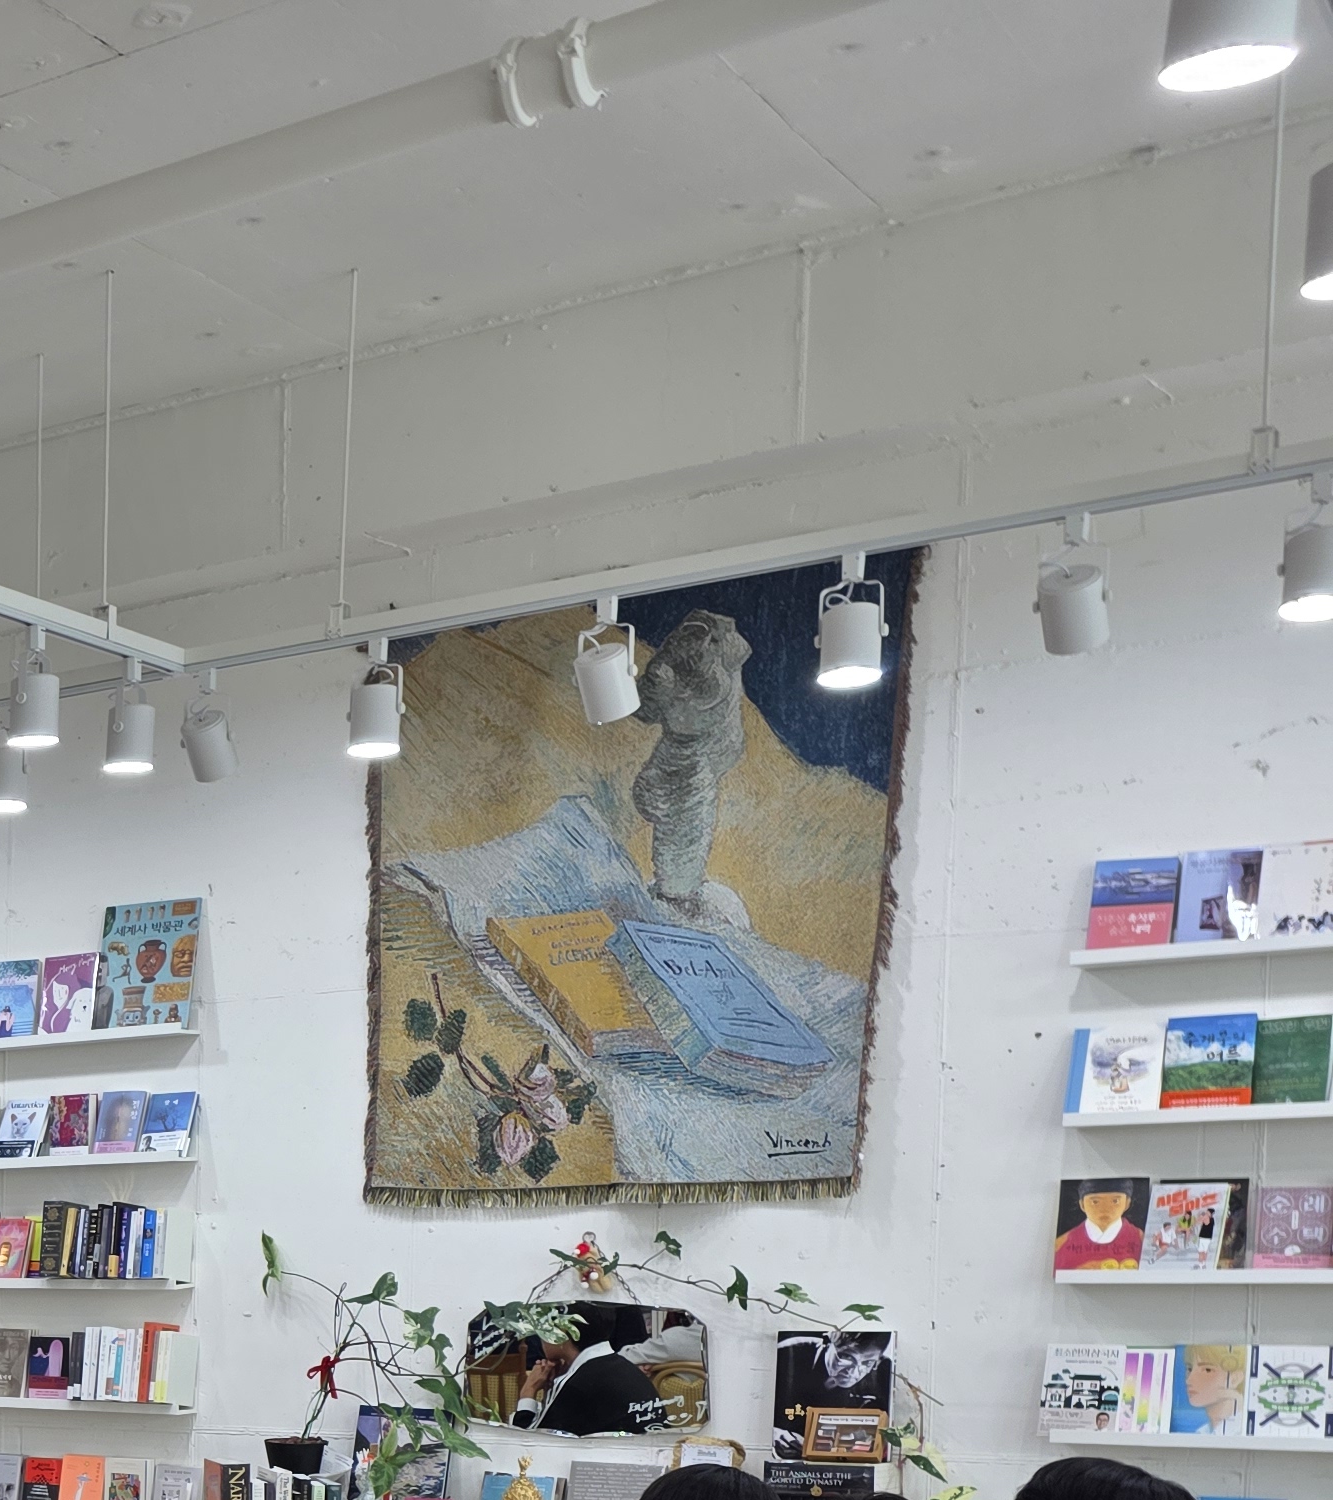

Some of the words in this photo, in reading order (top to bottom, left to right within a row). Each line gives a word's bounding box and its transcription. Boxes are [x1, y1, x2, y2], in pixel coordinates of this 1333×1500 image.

[114, 922, 147, 937] 세계사
[151, 919, 184, 934] 박물관
[788, 1470, 821, 1479] ANNALS
